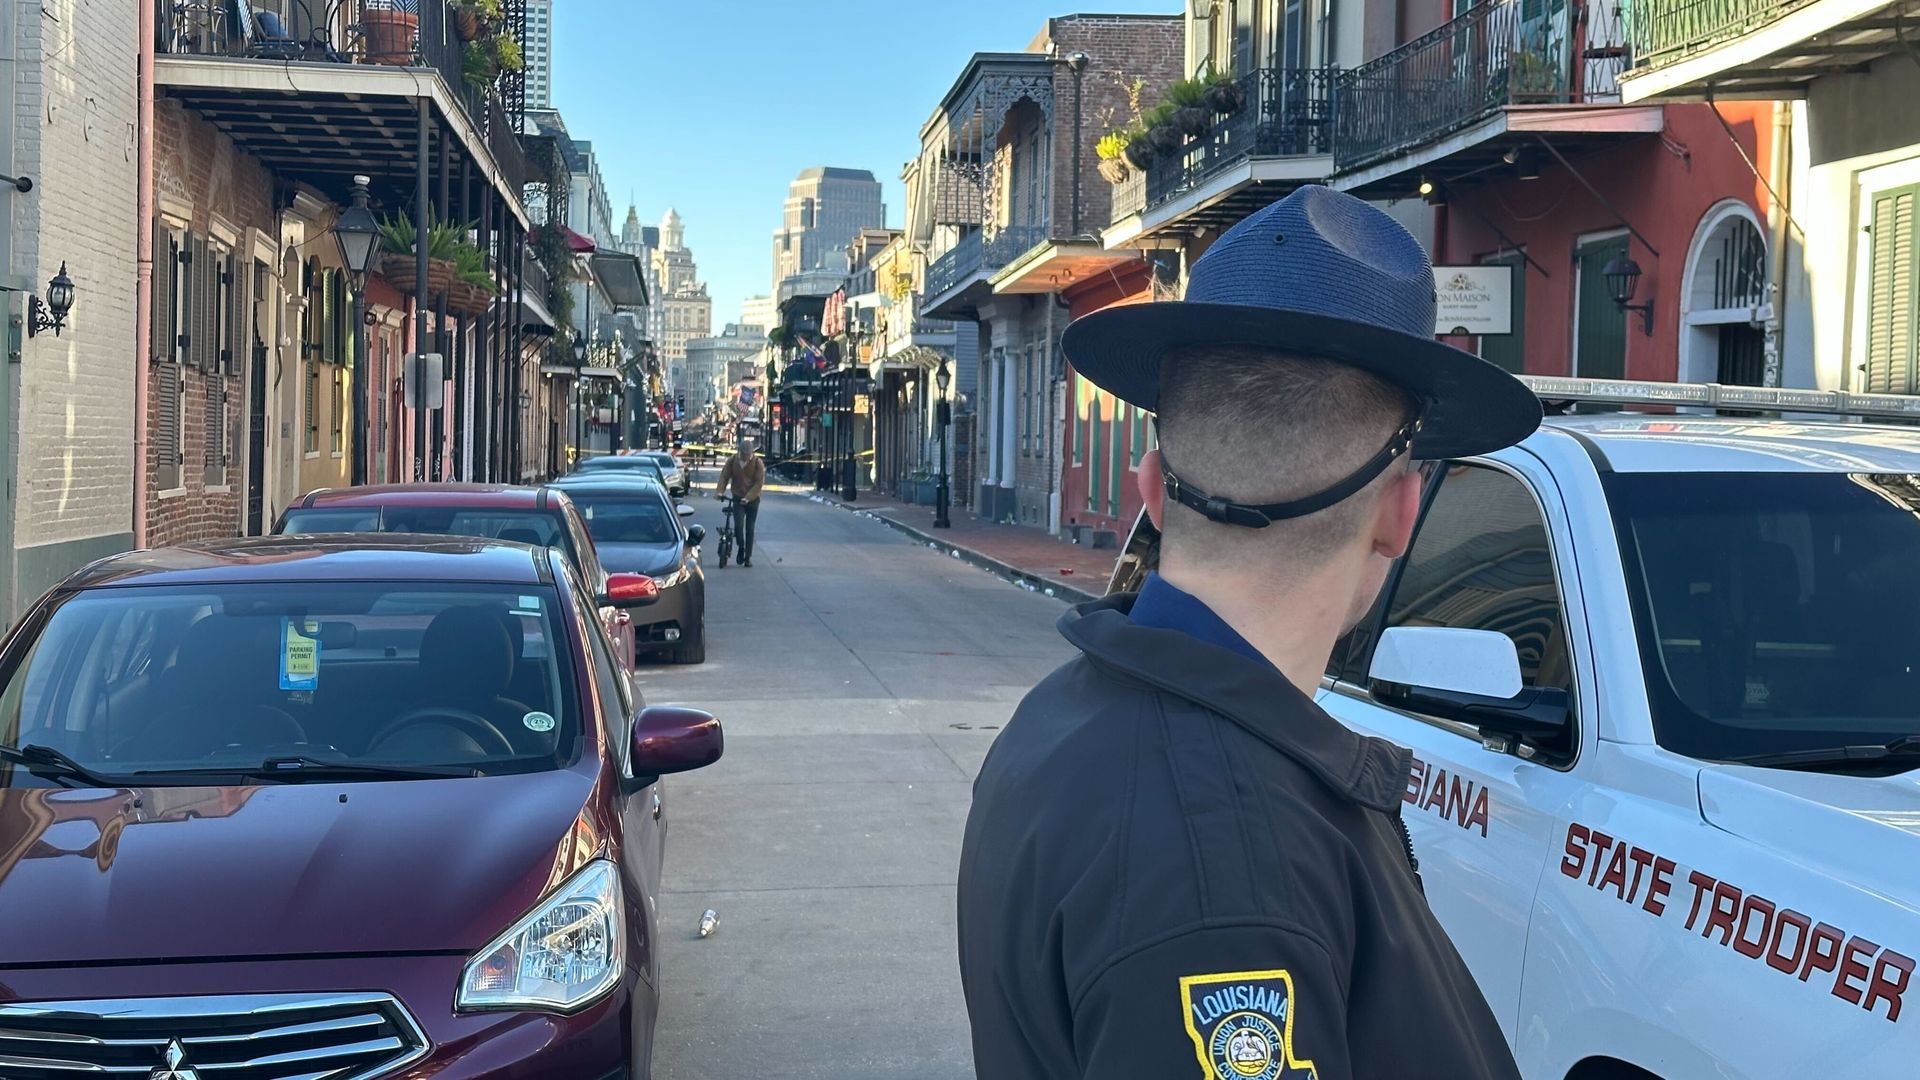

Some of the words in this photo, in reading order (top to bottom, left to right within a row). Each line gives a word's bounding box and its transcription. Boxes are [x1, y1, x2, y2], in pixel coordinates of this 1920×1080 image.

[1437, 294, 1451, 303] ON
[1453, 293, 1490, 302] MAISON
[1402, 757, 1489, 838] SIANA
[1560, 822, 1676, 917] STATE
[1684, 869, 1917, 1023] TROOPER
[1192, 985, 1288, 1025] LOUISIANA
[1213, 1021, 1237, 1055] UNION
[1242, 1015, 1281, 1052] JUSTICE
